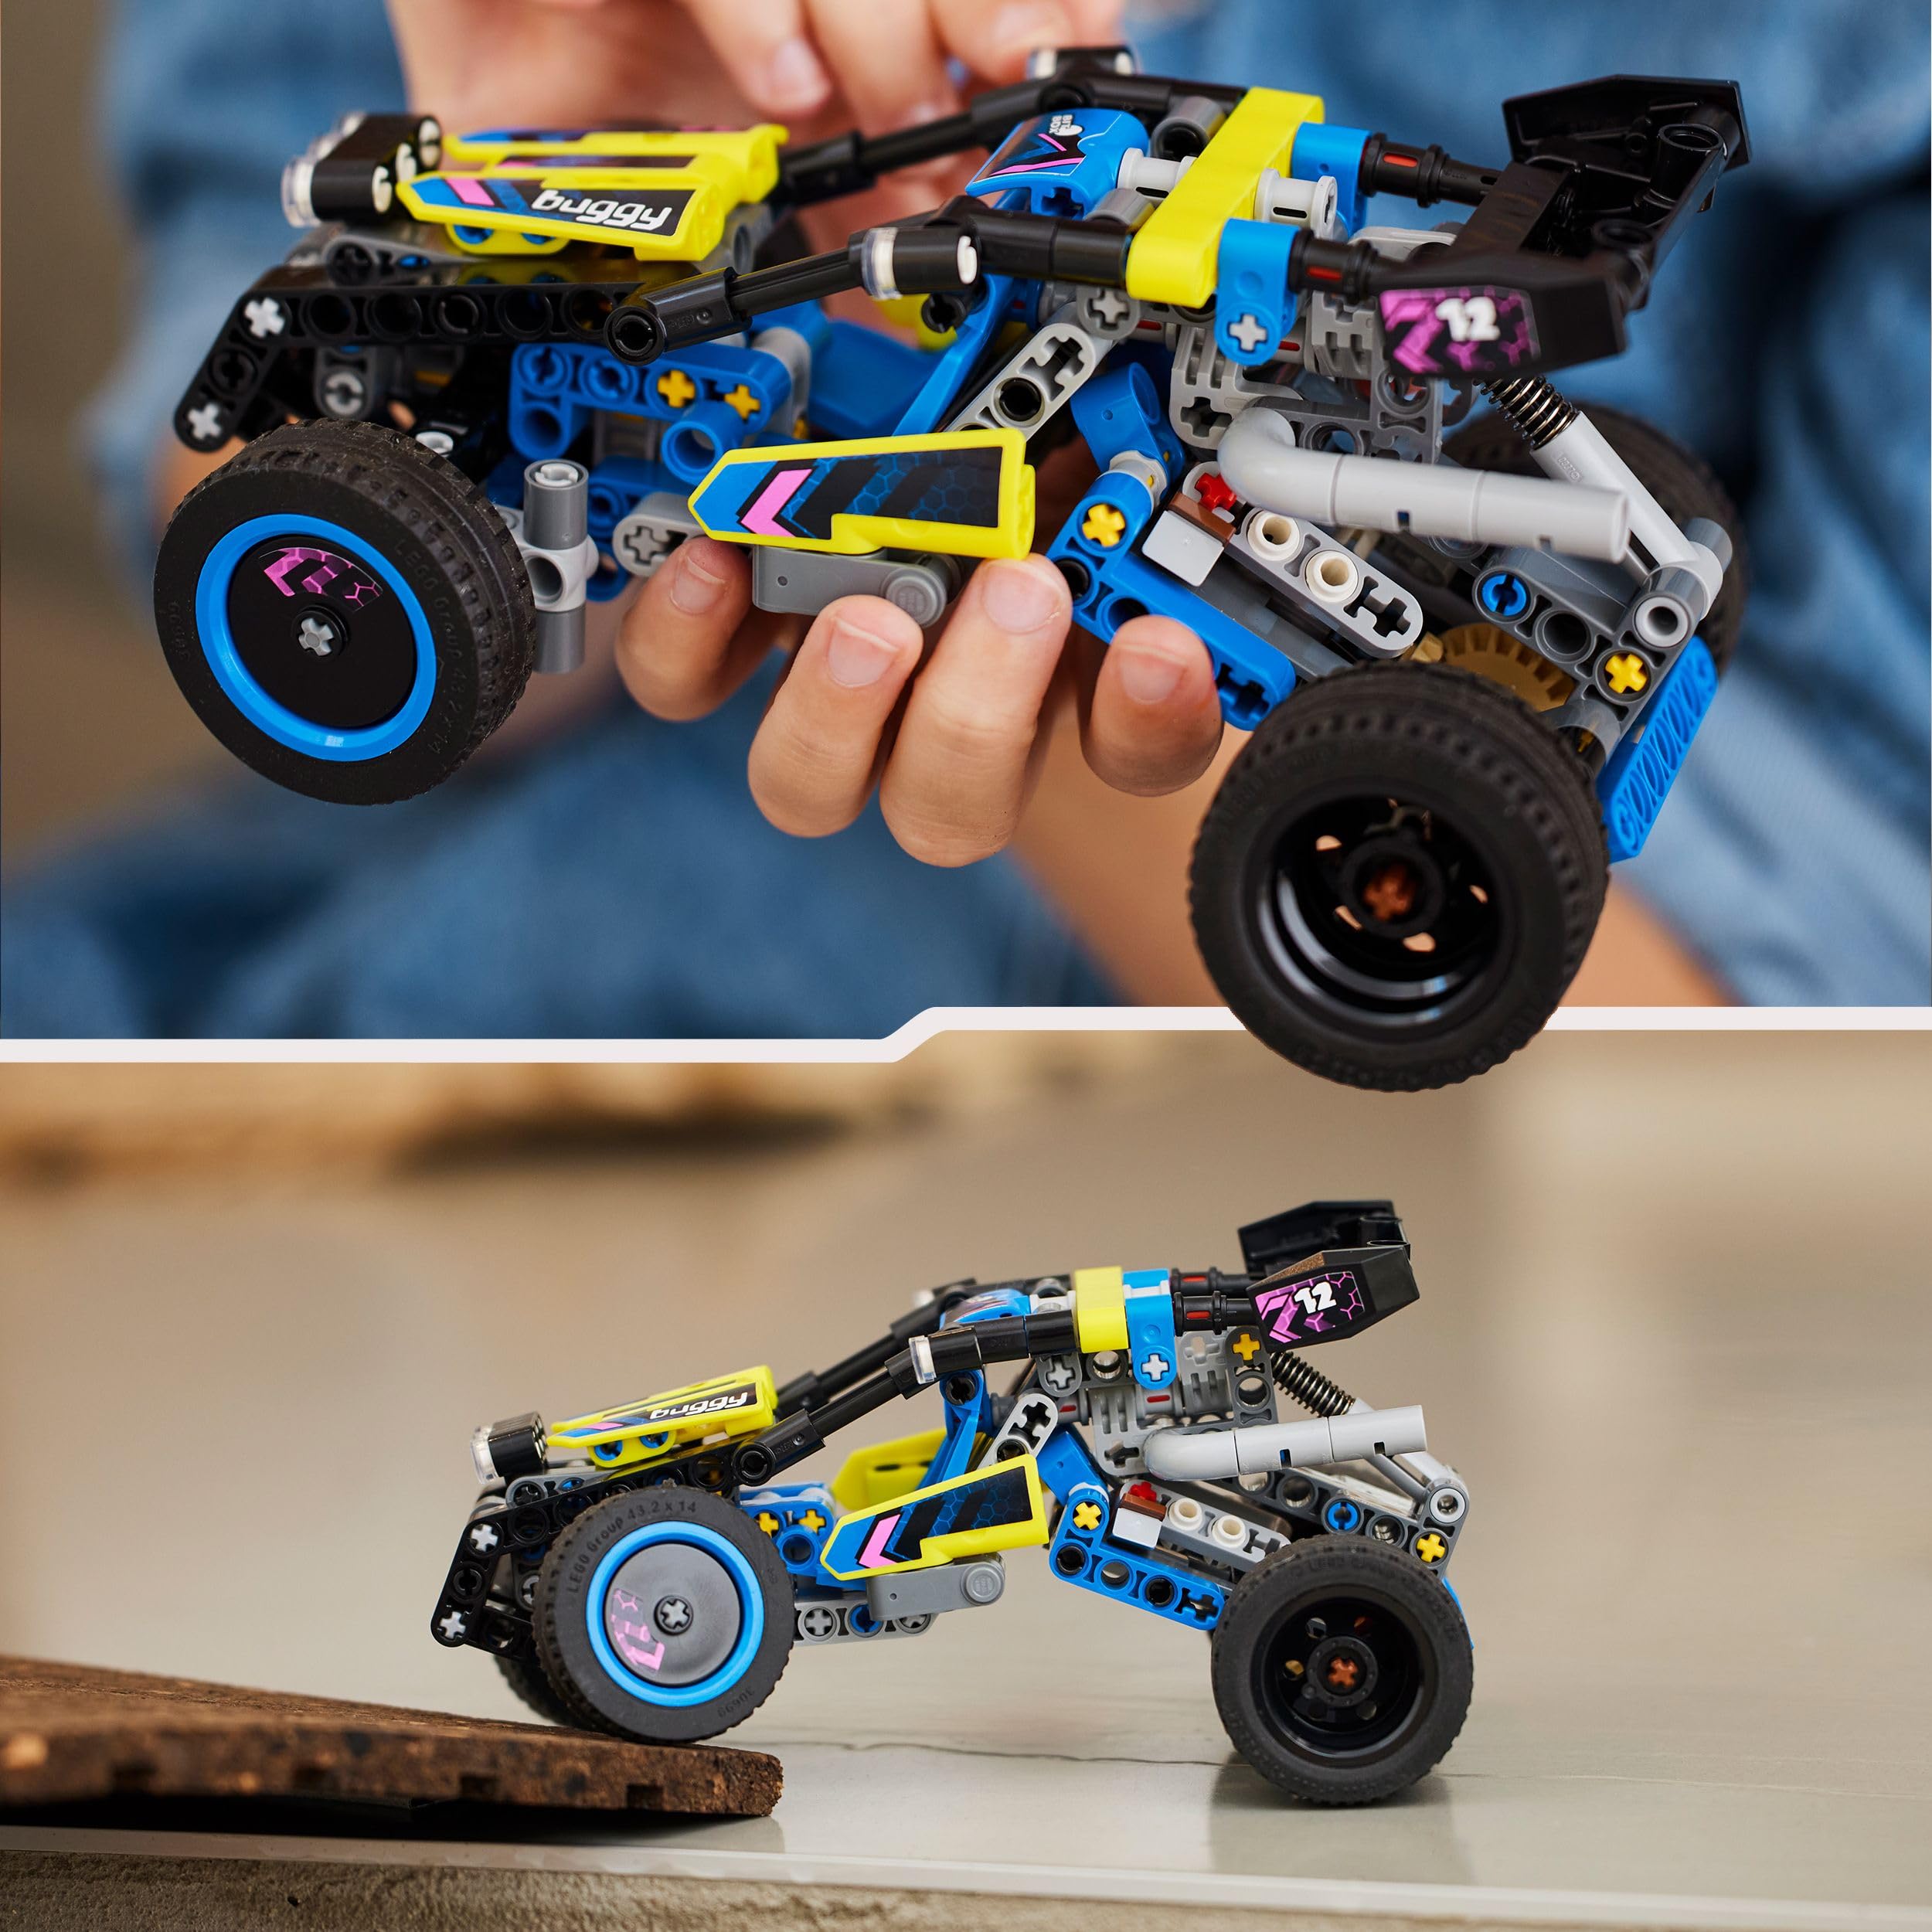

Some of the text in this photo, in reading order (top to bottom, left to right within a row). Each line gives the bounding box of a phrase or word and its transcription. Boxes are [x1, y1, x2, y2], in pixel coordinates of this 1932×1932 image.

[531, 189, 672, 231] buggy
[1435, 296, 1502, 342] 12
[1294, 1281, 1337, 1314] 12
[649, 1392, 748, 1420] buggy
[567, 1554, 590, 1594] LEGO
[587, 1516, 624, 1553] Group
[627, 1501, 659, 1521] 43.2
[678, 1501, 696, 1513] 14
